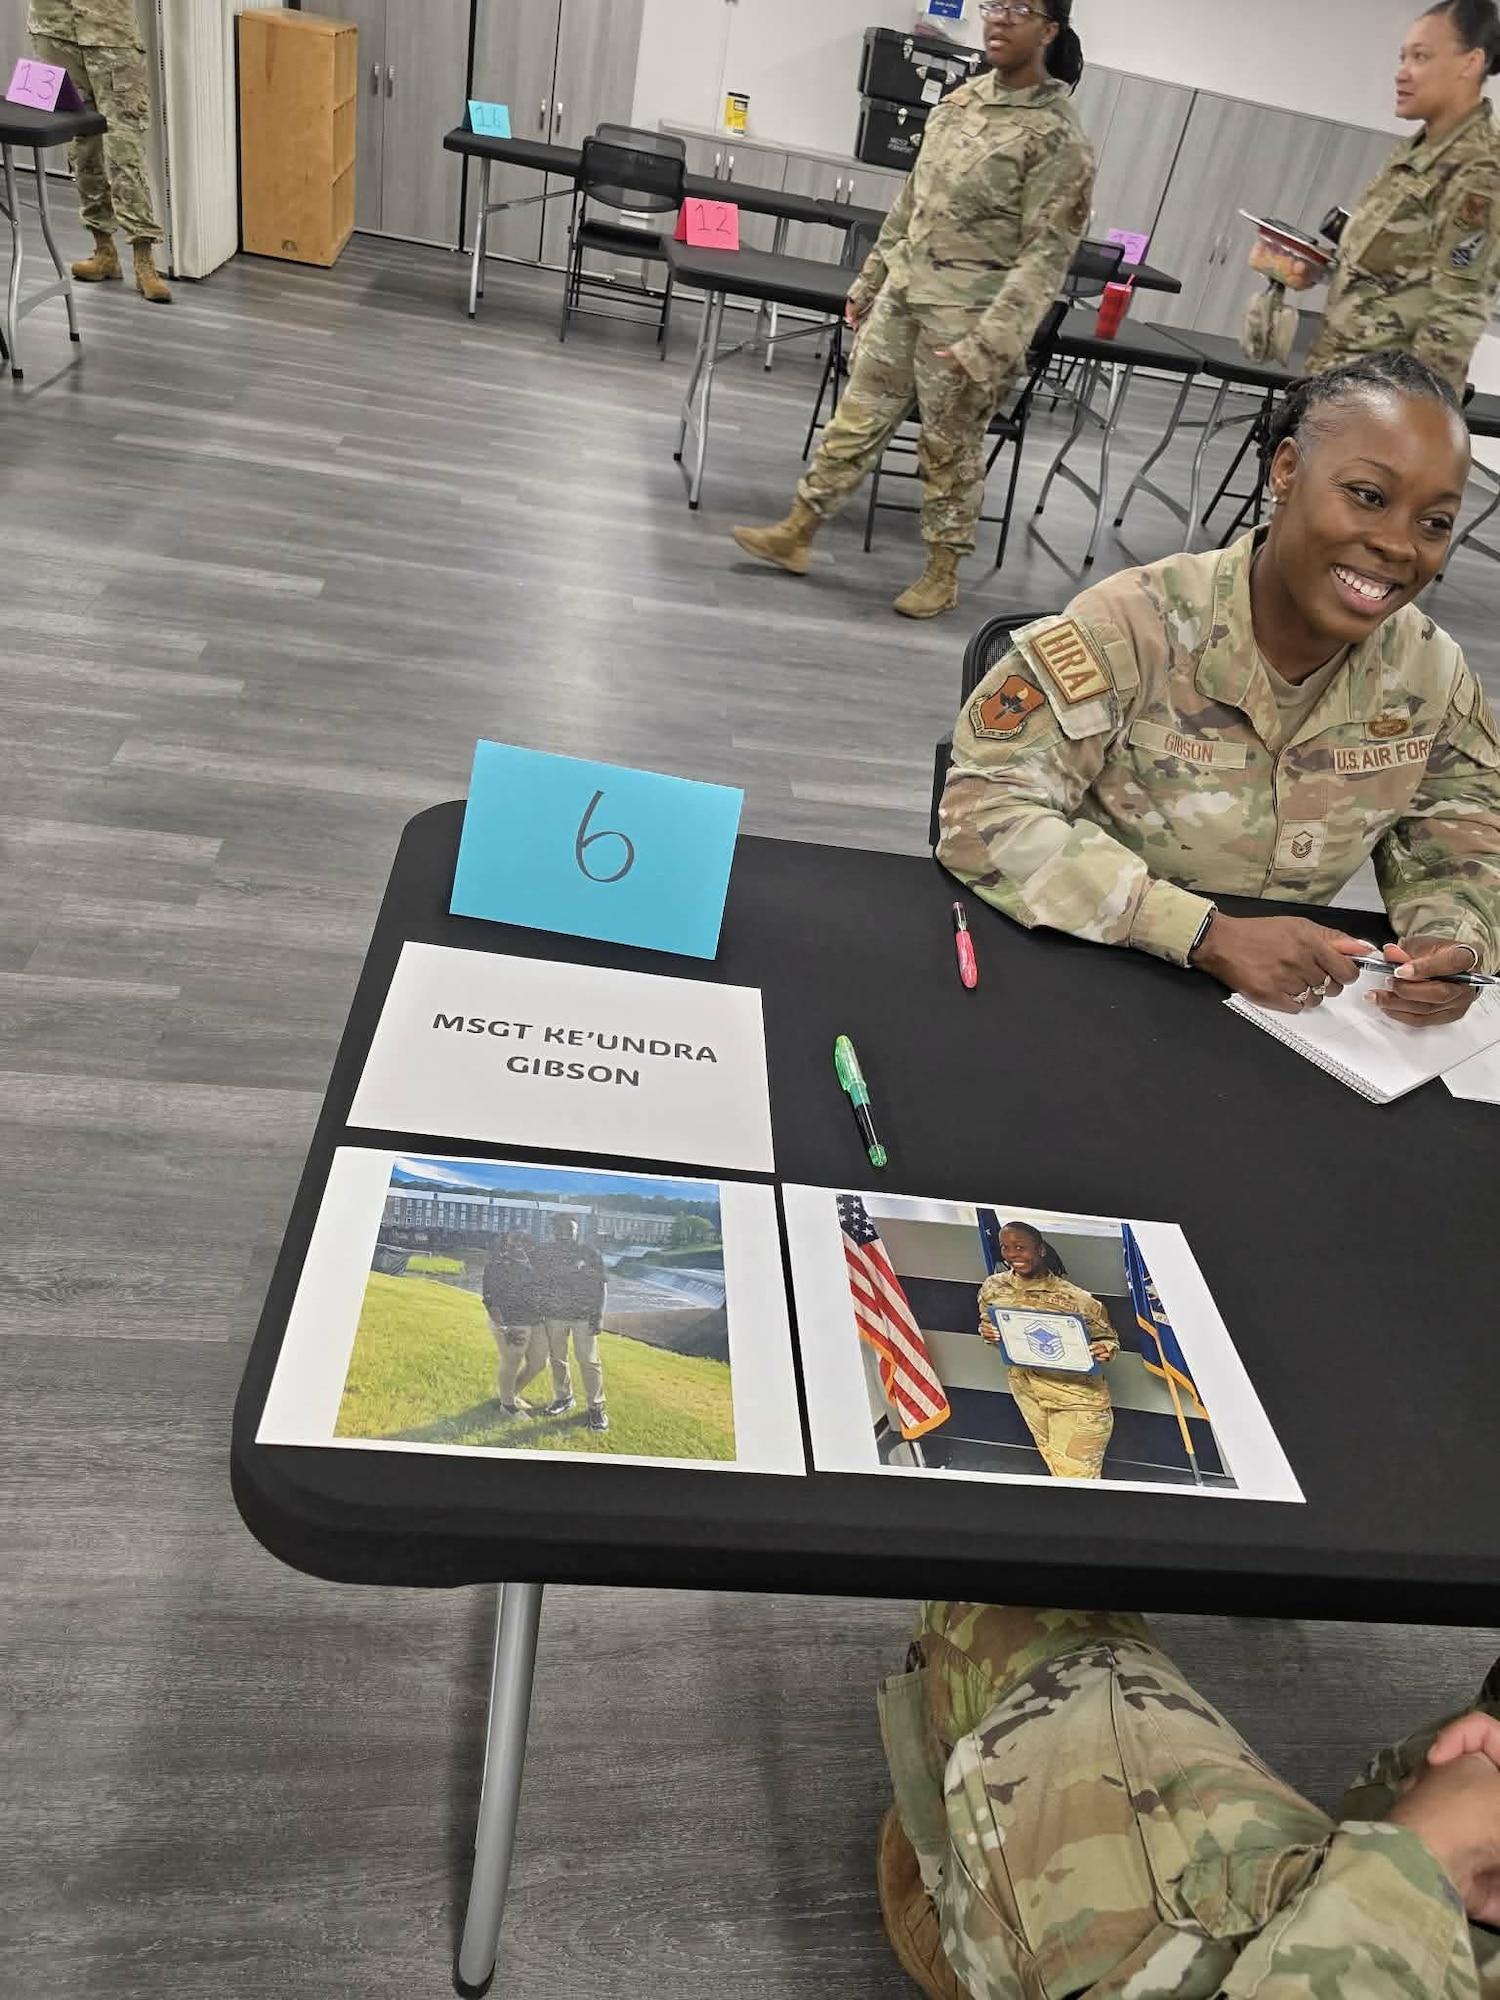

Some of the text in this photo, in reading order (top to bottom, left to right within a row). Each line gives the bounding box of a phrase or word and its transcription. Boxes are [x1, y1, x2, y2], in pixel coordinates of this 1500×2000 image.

[15, 63, 56, 100] 13
[695, 204, 732, 236] 12
[1041, 630, 1097, 692] HRA
[1163, 732, 1214, 763] GIBSON
[1336, 750, 1361, 771] U.S.
[1362, 747, 1394, 769] AIR
[575, 789, 636, 884] 6
[432, 1013, 534, 1040] MSGT
[506, 1055, 640, 1087] GIBSON
